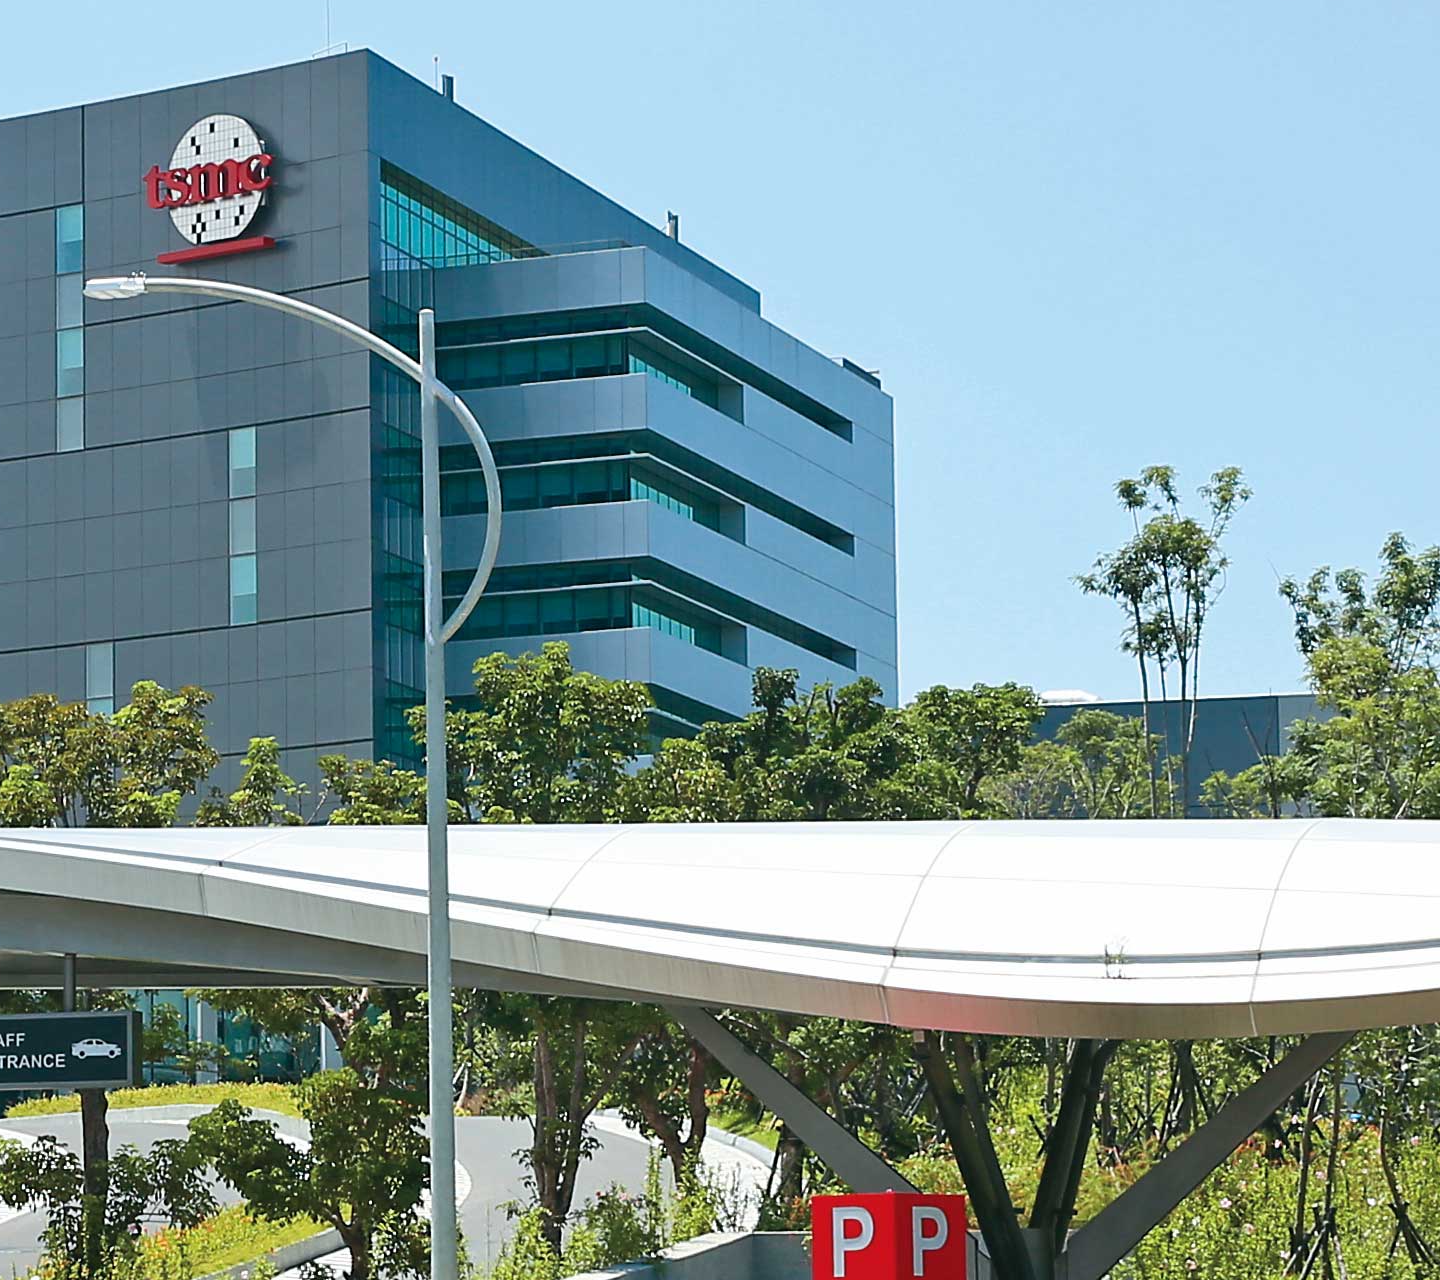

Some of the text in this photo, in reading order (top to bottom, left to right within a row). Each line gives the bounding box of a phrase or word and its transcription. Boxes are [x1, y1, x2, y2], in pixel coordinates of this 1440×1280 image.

[142, 153, 273, 209] tsmc
[832, 1206, 874, 1278] P
[912, 1206, 948, 1277] P
